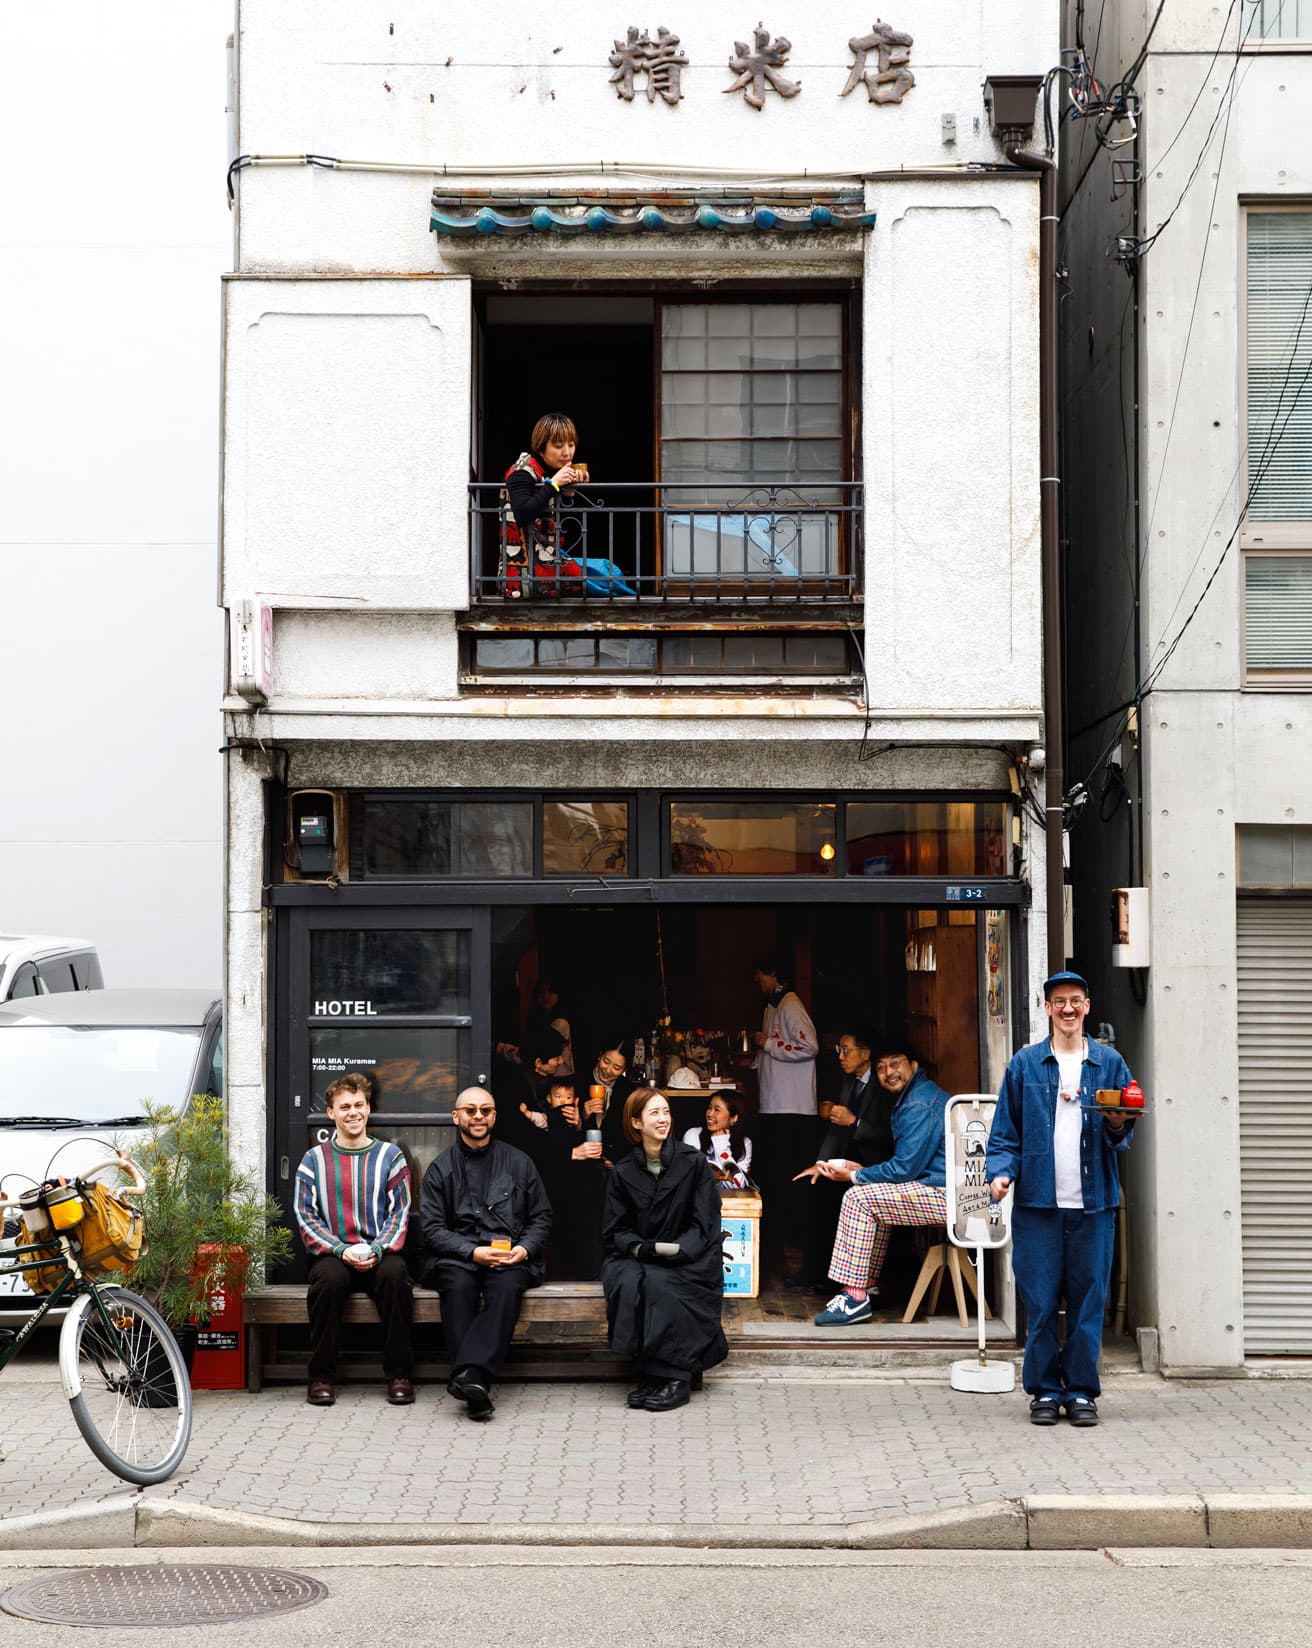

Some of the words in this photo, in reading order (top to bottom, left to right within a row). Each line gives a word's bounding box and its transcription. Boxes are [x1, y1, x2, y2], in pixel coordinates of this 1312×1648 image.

[608, 19, 916, 110] 精米店
[966, 889, 982, 898] 3-2
[315, 1001, 377, 1015] HOTEL
